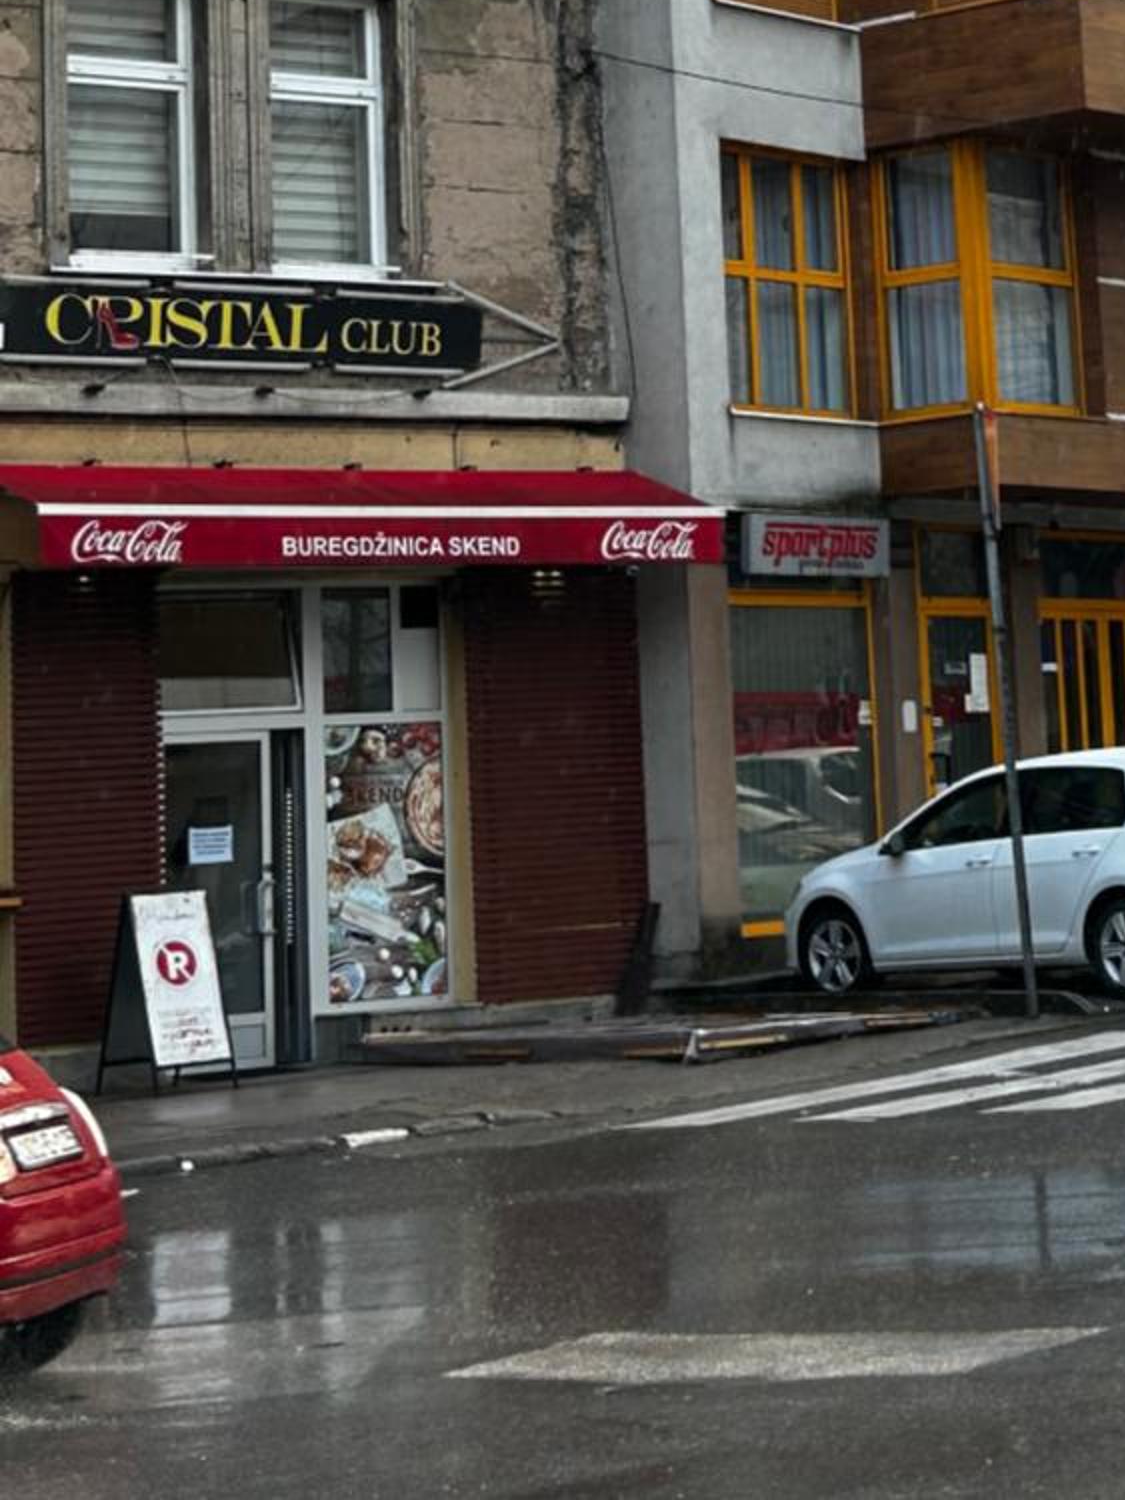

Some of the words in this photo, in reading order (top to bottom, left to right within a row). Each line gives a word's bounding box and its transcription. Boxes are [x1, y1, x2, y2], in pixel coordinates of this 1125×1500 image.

[45, 293, 328, 353] CRISTAL
[341, 317, 442, 356] CLUB
[71, 519, 188, 563] Coca-Cola
[282, 531, 444, 557] BUREGDŽINICA
[448, 536, 520, 557] SKEND
[601, 520, 698, 559] Coca-Cola
